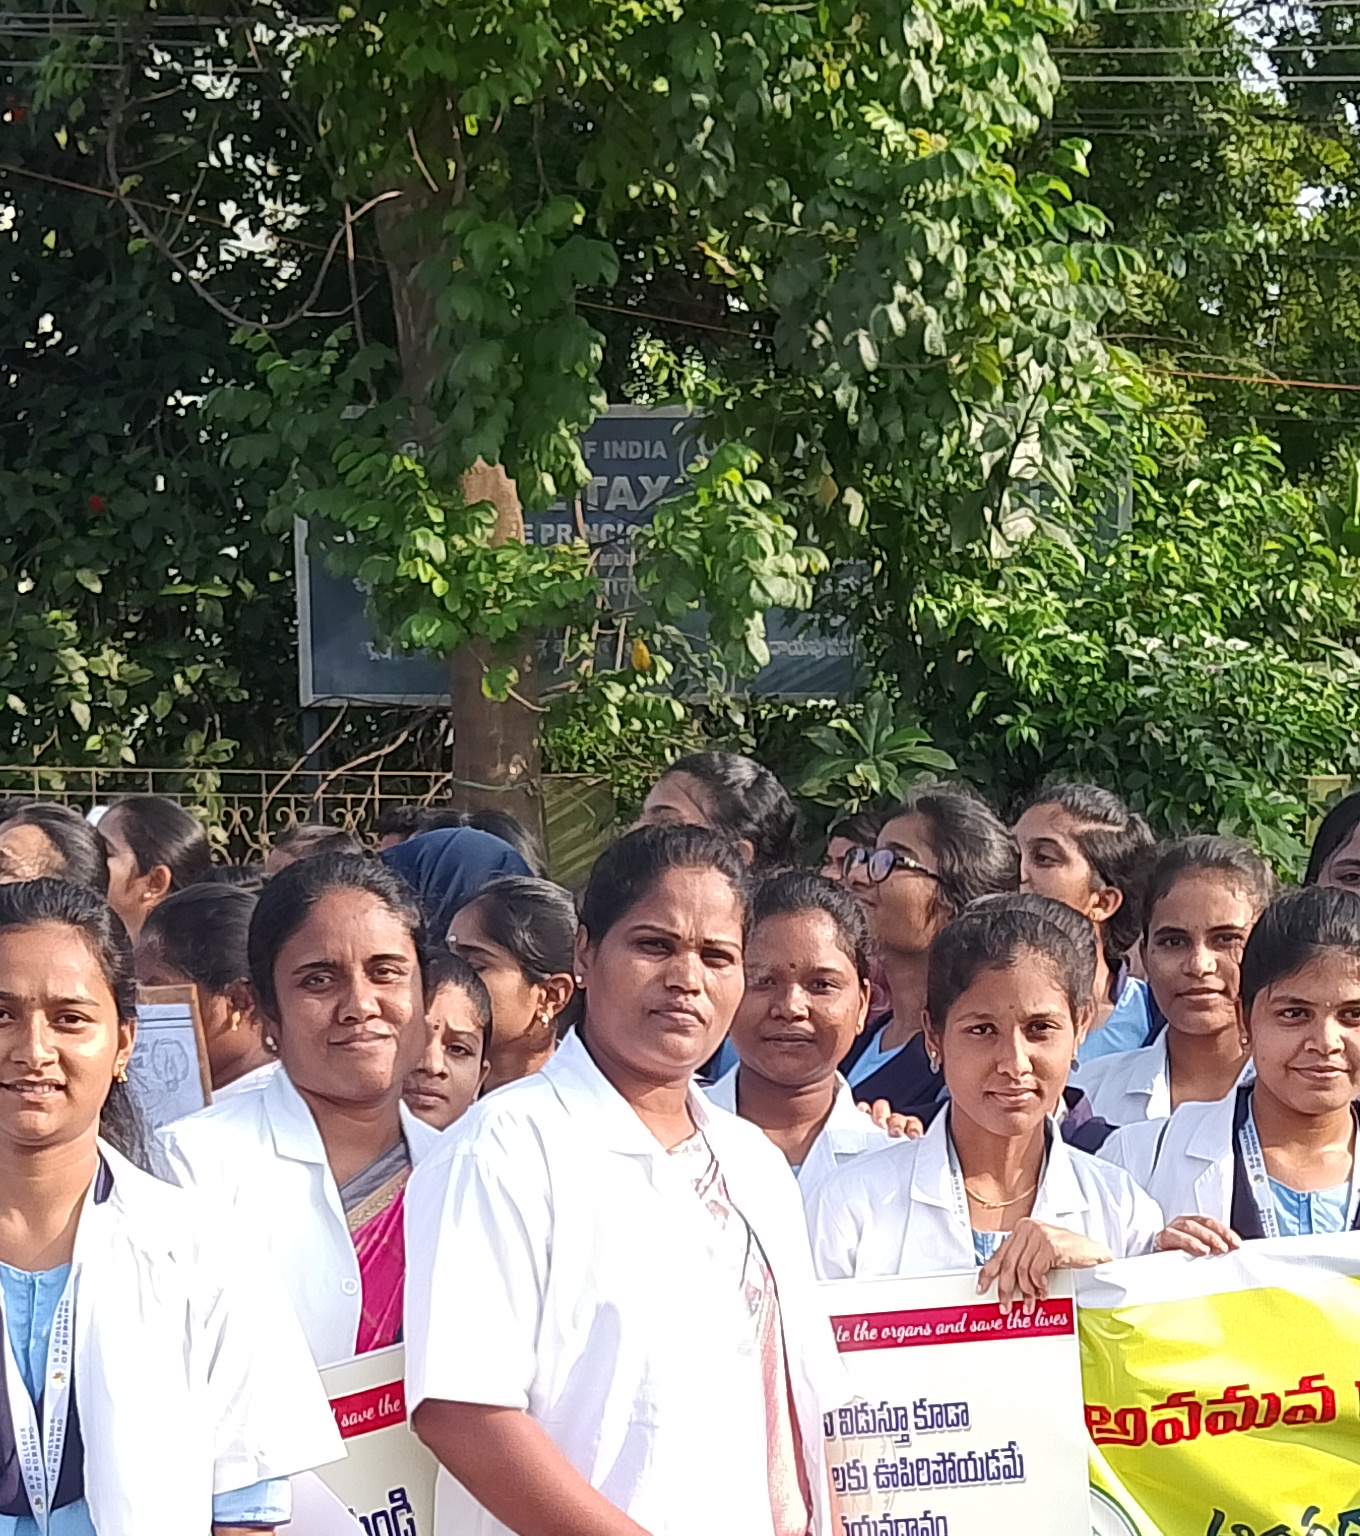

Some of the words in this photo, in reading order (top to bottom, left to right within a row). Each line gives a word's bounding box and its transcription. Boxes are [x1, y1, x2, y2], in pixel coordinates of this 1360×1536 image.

[604, 440, 668, 461] INDIA
[586, 475, 670, 512] TAX
[854, 1320, 879, 1342] the
[881, 1323, 933, 1345] organs
[935, 1313, 966, 1336] and
[969, 1318, 1003, 1333] save
[1006, 1309, 1031, 1329] the
[1034, 1307, 1069, 1328] lives
[341, 1410, 376, 1428] save
[377, 1396, 402, 1423] the
[839, 1400, 911, 1444] విడుస్తూ
[913, 1397, 971, 1431] కూడా
[873, 1440, 1026, 1493] ఊపిరిపోయడమే
